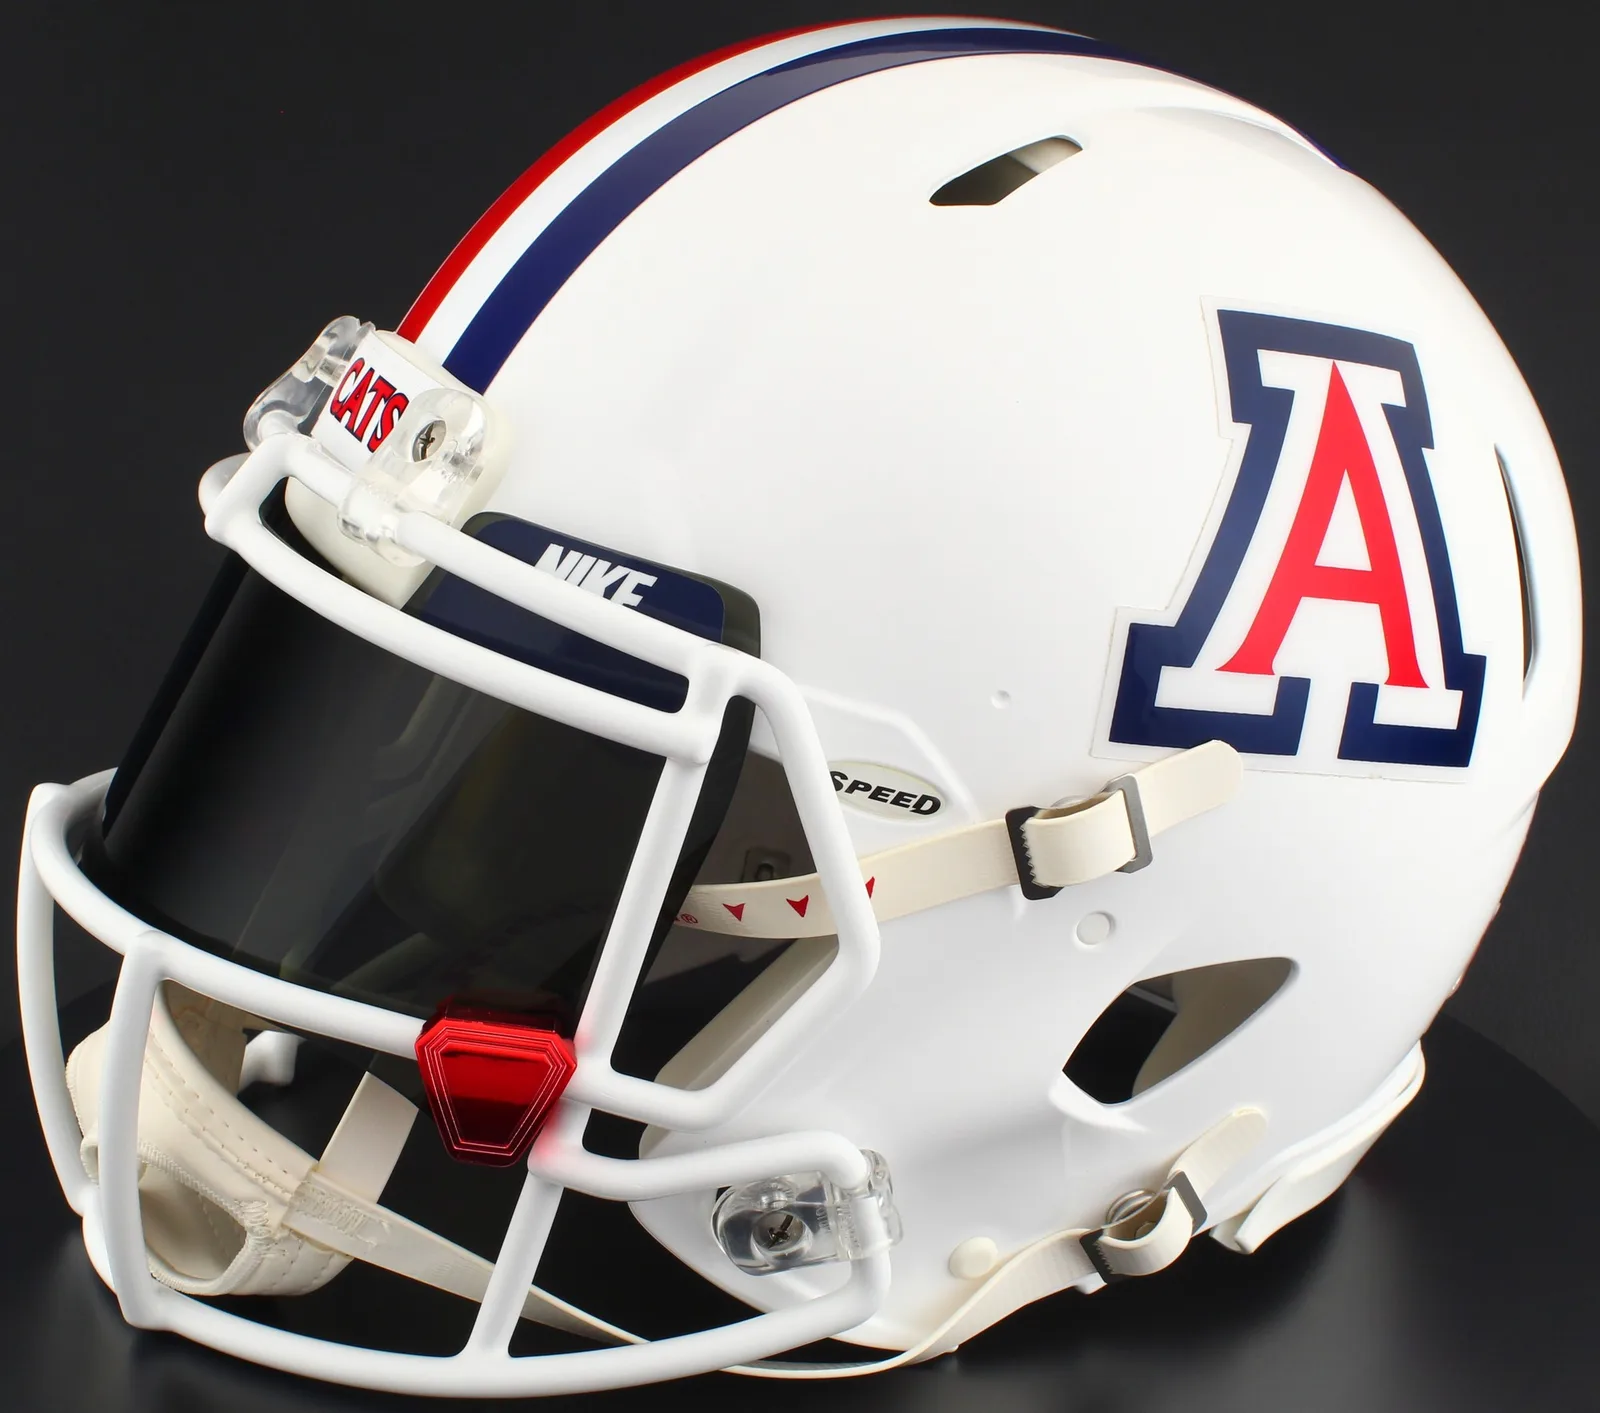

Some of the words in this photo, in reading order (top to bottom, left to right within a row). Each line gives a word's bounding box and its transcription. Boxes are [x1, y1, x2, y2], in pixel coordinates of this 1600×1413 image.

[330, 357, 410, 453] CATS
[1109, 309, 1486, 767] A
[830, 771, 941, 815] SPEED
